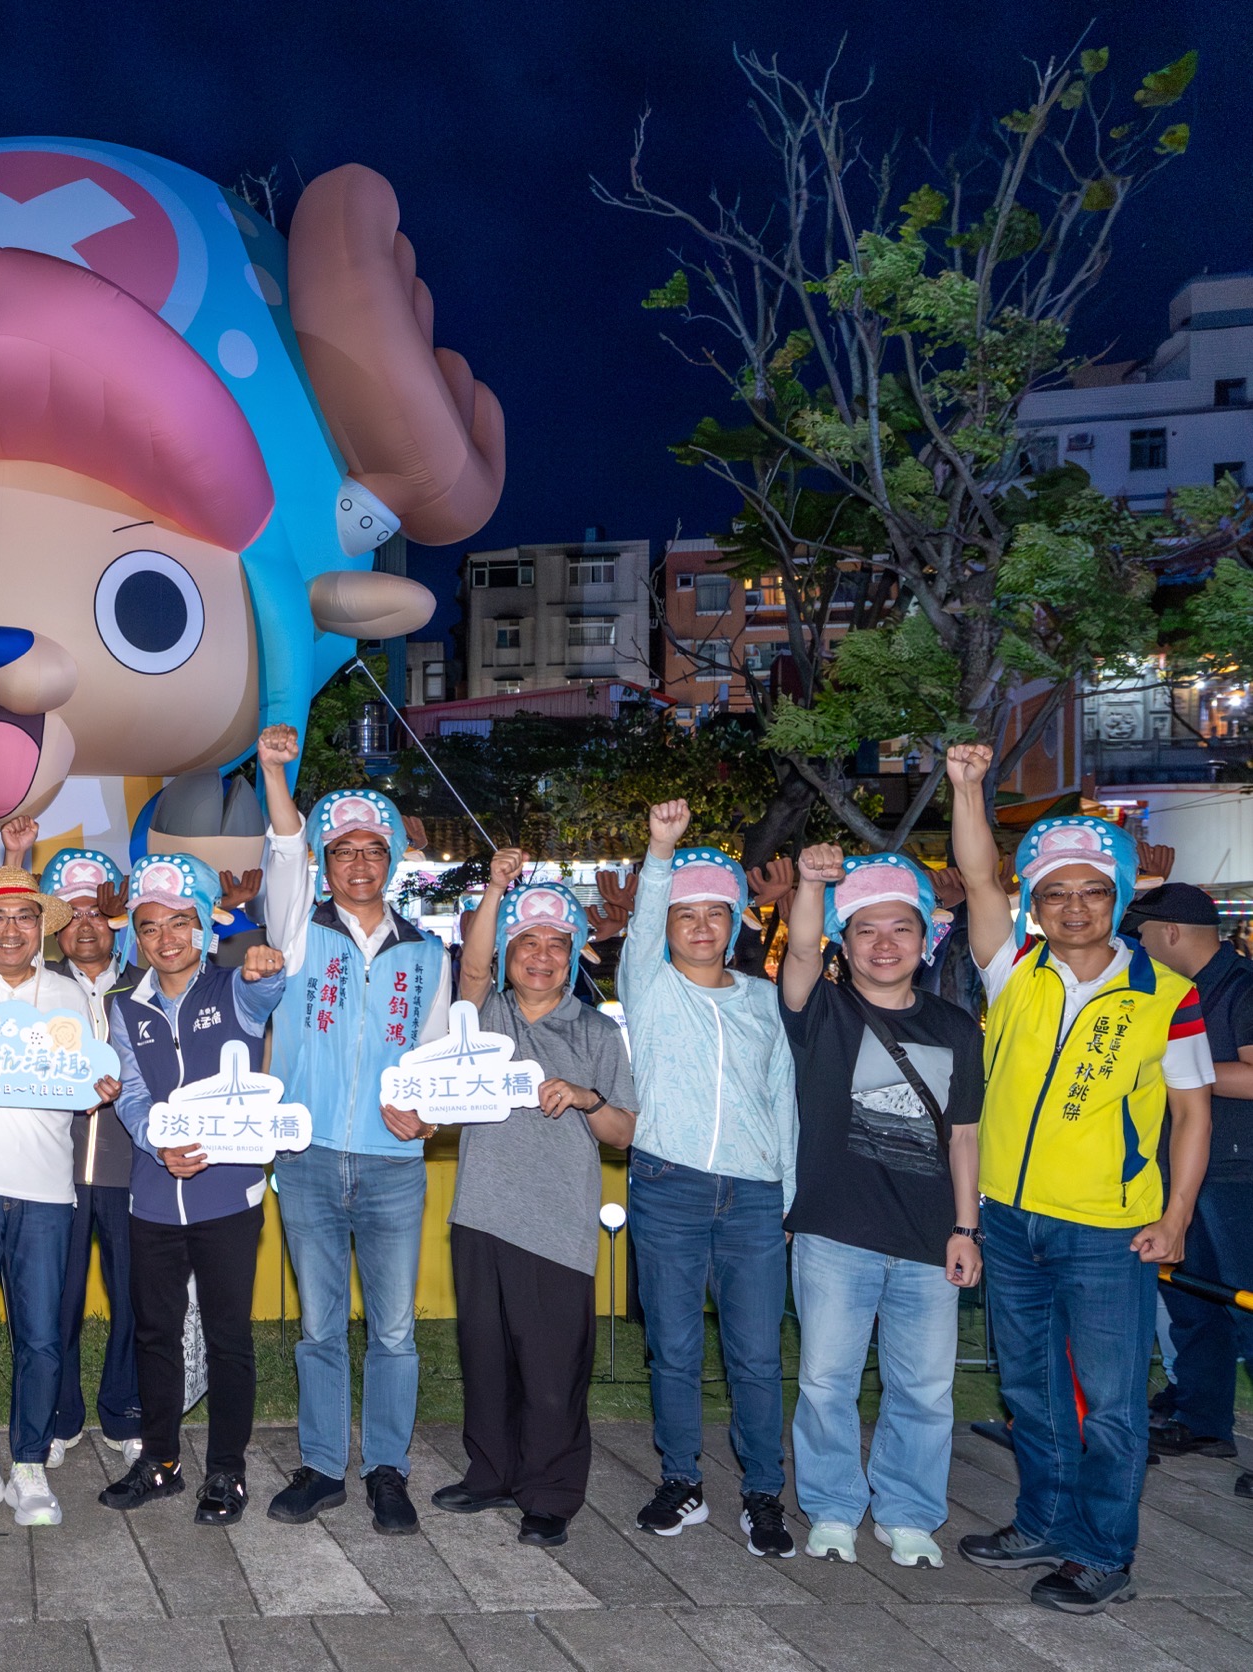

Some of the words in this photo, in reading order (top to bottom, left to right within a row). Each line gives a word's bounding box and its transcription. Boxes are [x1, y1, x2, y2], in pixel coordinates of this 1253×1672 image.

[317, 957, 341, 1033] 蔡錦賢
[1086, 1016, 1109, 1054] 區長
[1098, 1013, 1132, 1079] 八里區公所
[392, 1071, 533, 1100] 淡江大橋
[429, 1105, 467, 1113] DANJIANG
[159, 1114, 300, 1139] 淡江大橋
[201, 1143, 233, 1152] ANJIANG
